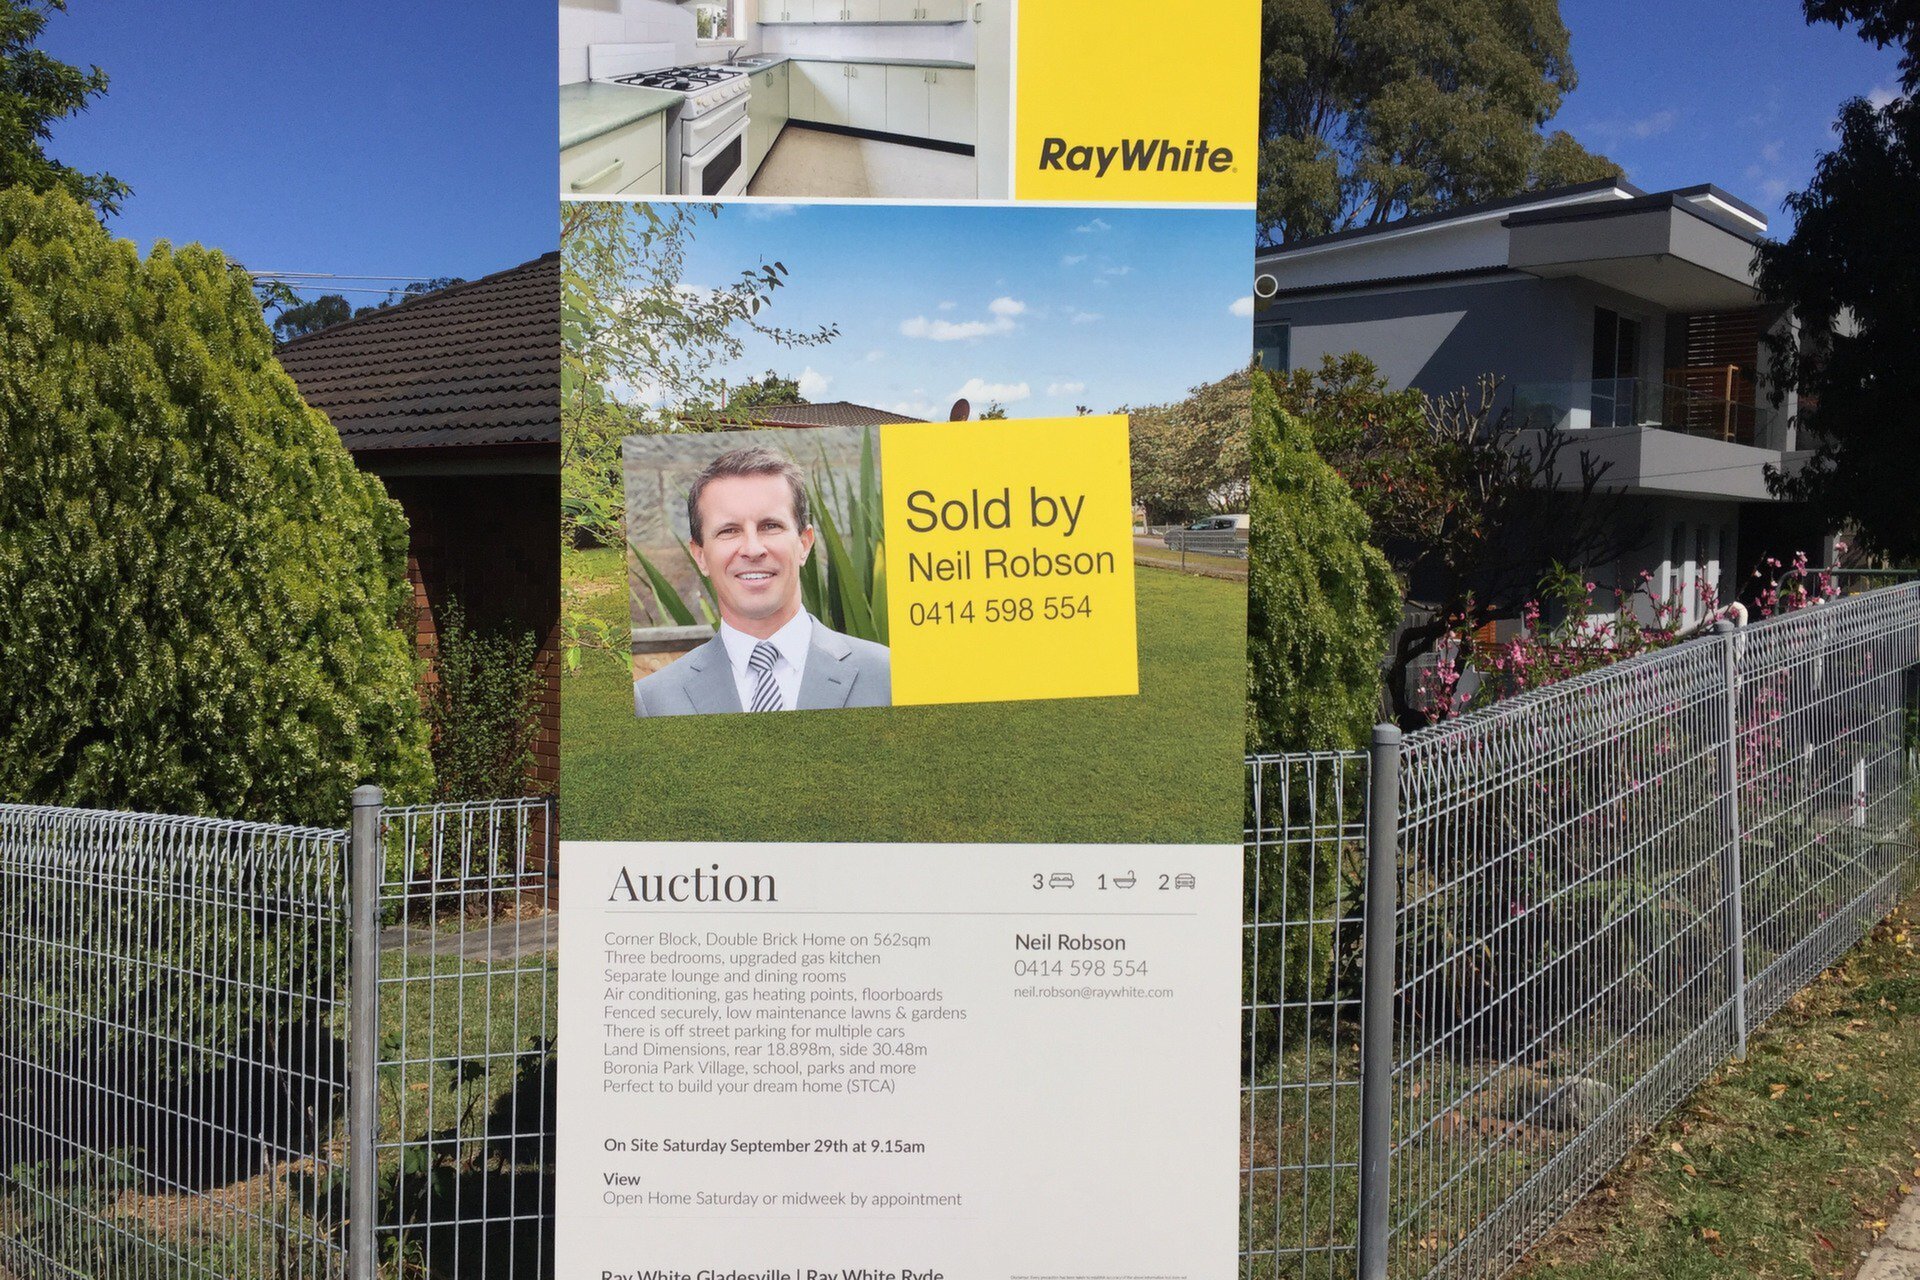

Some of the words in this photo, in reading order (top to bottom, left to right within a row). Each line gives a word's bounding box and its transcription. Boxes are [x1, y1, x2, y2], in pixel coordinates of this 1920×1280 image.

[906, 487, 1011, 532] Sold
[1030, 486, 1085, 537] by
[909, 550, 971, 582] Neil
[985, 547, 1114, 579] Robson
[910, 600, 975, 626] 0414
[985, 598, 1034, 623] 598
[1044, 595, 1092, 620] 554
[608, 864, 778, 902] Auction
[1033, 873, 1044, 890] 3
[1098, 874, 1107, 890] 1
[1159, 874, 1169, 890] 2
[604, 932, 652, 946] Corner
[658, 932, 701, 948] Block,
[707, 932, 758, 946] Double
[763, 932, 799, 946] Brick
[803, 933, 846, 946] Home
[850, 936, 868, 946] on
[874, 933, 933, 950] 562sqm
[1016, 934, 1051, 950] Neil
[1058, 934, 1125, 950] Robson
[604, 950, 645, 964] Three
[651, 951, 725, 966] bedrooms,
[730, 951, 796, 967] upgraded
[801, 954, 824, 967] gas
[830, 951, 880, 965] kitchen
[1014, 960, 1064, 976] 0414
[1070, 960, 1105, 976] 598
[1113, 960, 1148, 977] 554
[603, 969, 667, 985] Separate
[672, 969, 719, 985] lounge
[724, 969, 750, 983] and
[755, 969, 798, 986] dining
[803, 970, 846, 983] rooms
[604, 987, 624, 1000] Air
[629, 986, 720, 1004] conditioning,
[725, 991, 748, 1004] gas
[753, 987, 807, 1004] heating
[810, 988, 857, 1004] points,
[862, 987, 943, 1002] floorboards
[1014, 986, 1173, 1000] neil.robson@raywhite.com
[604, 1005, 655, 1020] Fenced
[661, 1006, 721, 1021] securely,
[727, 1005, 752, 1019] low
[756, 1006, 846, 1020] maintenance
[851, 1006, 891, 1020] lawns
[896, 1006, 907, 1019] &
[911, 1006, 967, 1023] gardens
[603, 1024, 645, 1037] There
[650, 1024, 660, 1037] is
[665, 1024, 684, 1037] off
[689, 1025, 730, 1038] street
[735, 1024, 786, 1040] parking
[791, 1024, 811, 1039] for
[816, 1024, 872, 1040] multiple
[875, 1028, 905, 1038] cars
[603, 1042, 637, 1056] Land
[644, 1042, 729, 1057] Dimensions,
[735, 1046, 762, 1056] rear
[768, 1041, 834, 1057] 18.898m,
[840, 1043, 868, 1056] side
[873, 1042, 927, 1056] 30.48m
[604, 1060, 658, 1075] Boronia
[664, 1060, 694, 1074] Park
[698, 1060, 748, 1077] Village,
[753, 1061, 802, 1077] school,
[807, 1061, 845, 1077] parks
[849, 1061, 875, 1075] and
[880, 1064, 916, 1074] more
[604, 1079, 654, 1093] Perfect
[659, 1081, 673, 1093] to
[679, 1079, 712, 1093] build
[717, 1082, 749, 1095] your
[753, 1079, 799, 1093] dream
[803, 1079, 842, 1094] home
[847, 1079, 895, 1094] (STCA)
[604, 1138, 626, 1151] On
[631, 1138, 658, 1152] Site
[663, 1139, 727, 1154] Saturday
[731, 1139, 810, 1155] September
[814, 1139, 848, 1152] 29th
[852, 1141, 867, 1153] at
[871, 1140, 925, 1153] 9.15am
[603, 1173, 640, 1186] View
[603, 1191, 643, 1207] Open
[648, 1191, 692, 1205] Home
[696, 1191, 759, 1207] Saturday
[762, 1194, 778, 1205] or
[782, 1192, 847, 1207] midweek
[851, 1192, 868, 1208] by
[872, 1193, 962, 1208] appointment
[602, 1271, 633, 1280] Ray
[637, 1270, 691, 1280] White
[697, 1269, 790, 1280] Gladesville
[807, 1270, 838, 1280] Ray
[842, 1269, 895, 1280] White
[902, 1269, 944, 1280] Ryde
